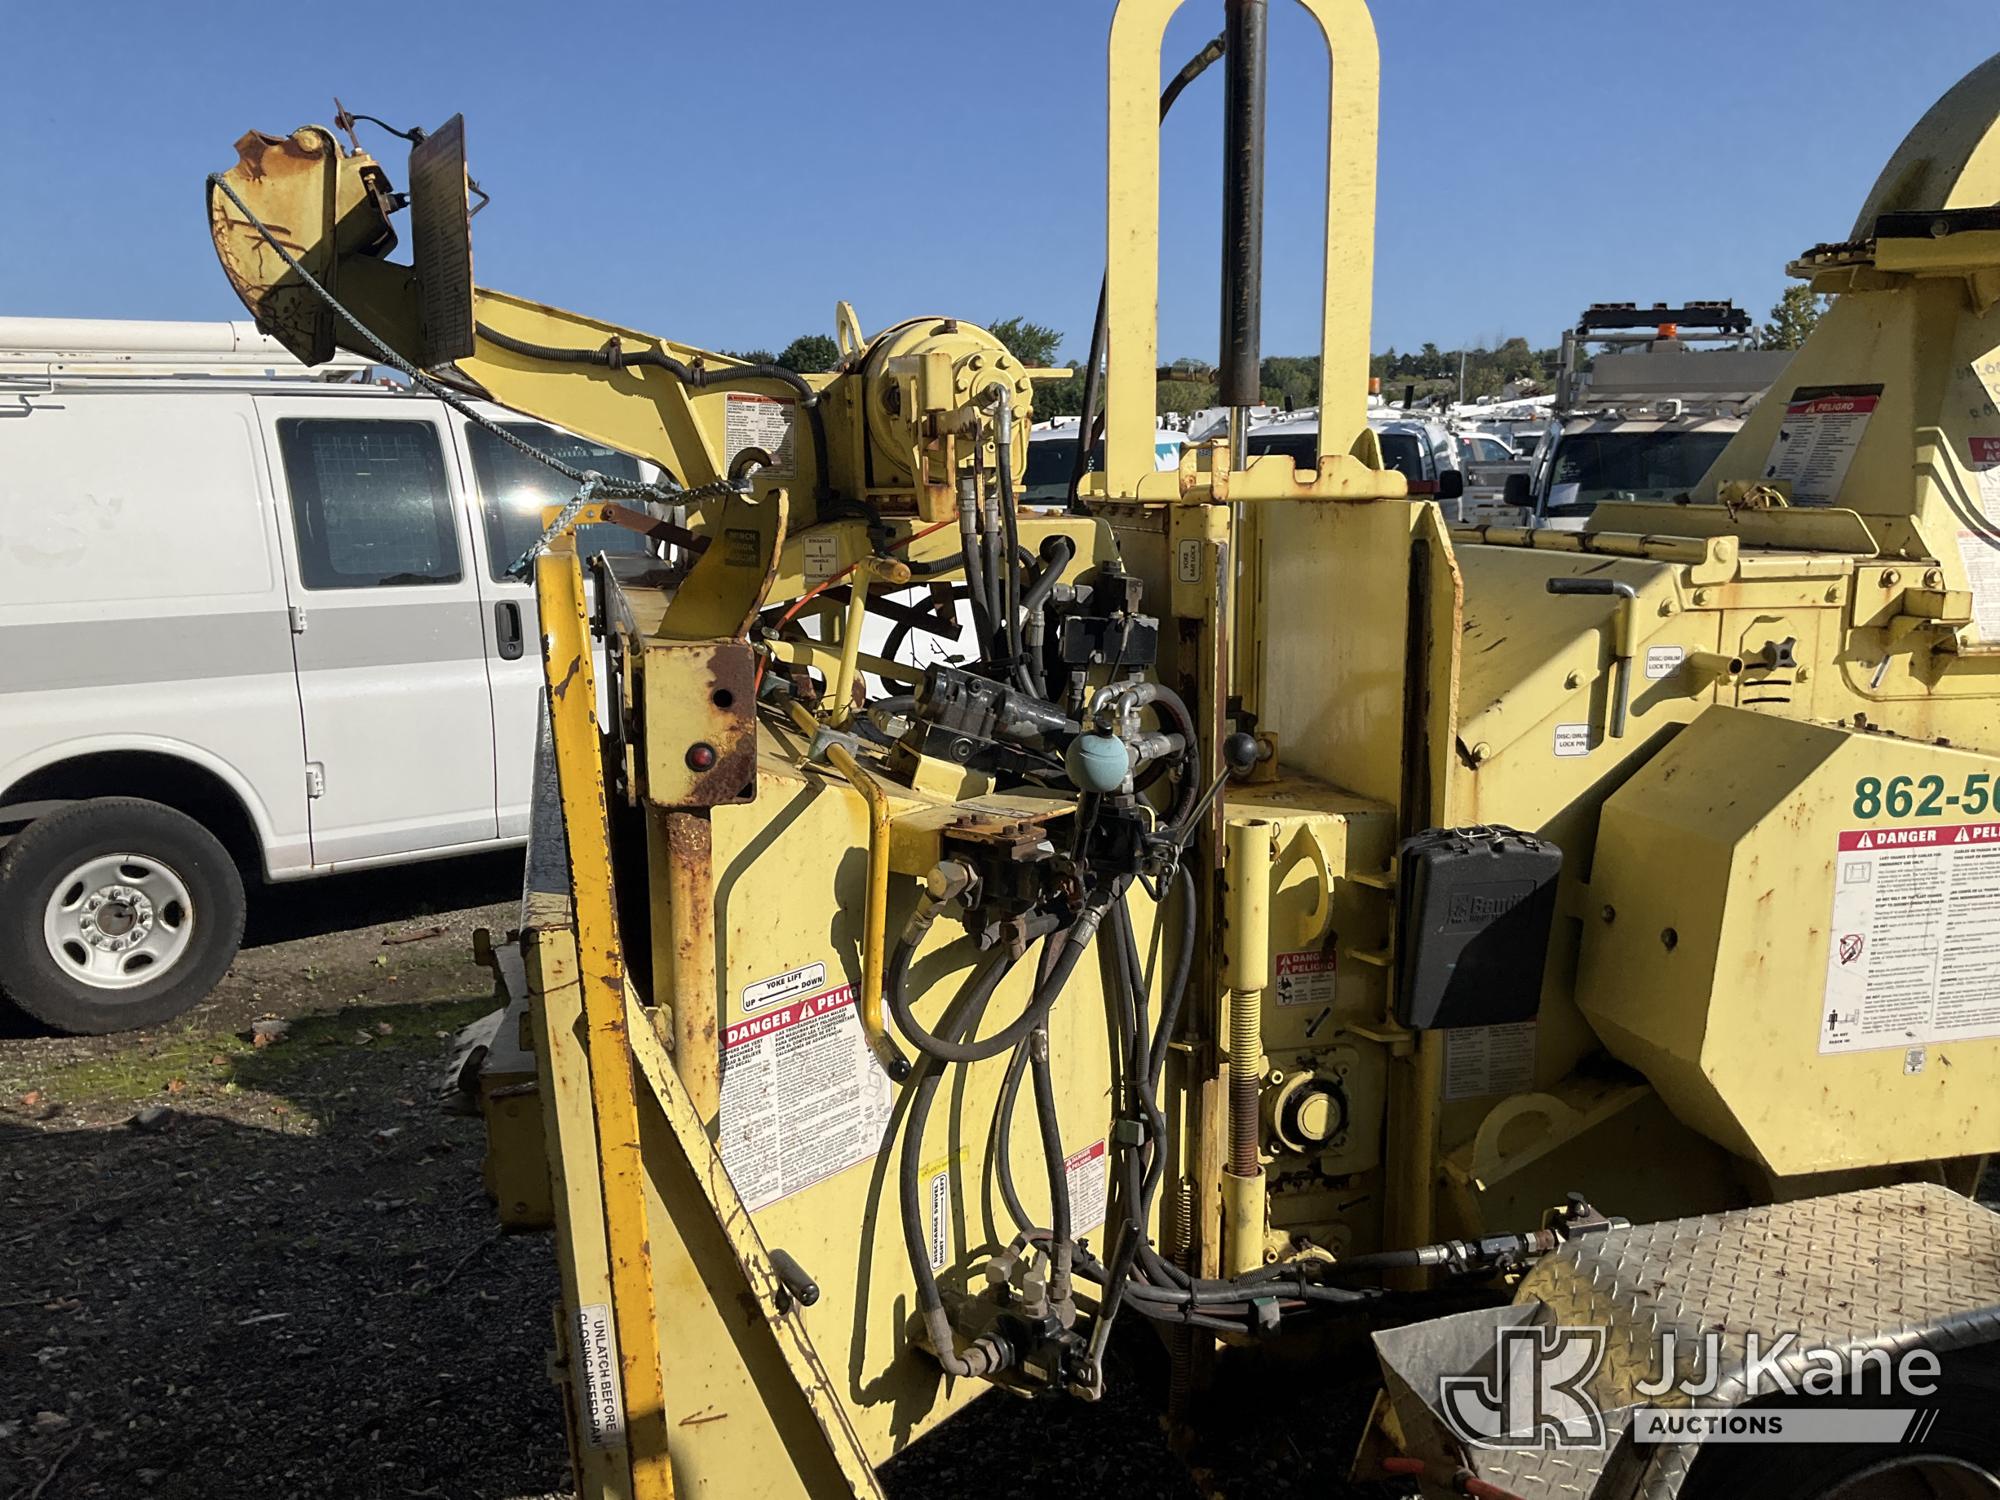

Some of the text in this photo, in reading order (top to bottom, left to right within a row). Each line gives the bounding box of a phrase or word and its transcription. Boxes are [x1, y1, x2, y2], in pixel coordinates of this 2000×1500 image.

[1816, 402, 1855, 412] PELIGRO
[1876, 826, 2000, 845] DANGER PEL
[1292, 953, 1333, 962] DANG
[766, 972, 803, 990] YOKE LIFT
[801, 976, 823, 989] DOWN
[745, 998, 756, 1008] UP
[727, 1010, 791, 1044] DANGER
[577, 1313, 602, 1444] CLOSING INFEED PAN
[593, 1320, 616, 1431] UNLATCH BEFORE
